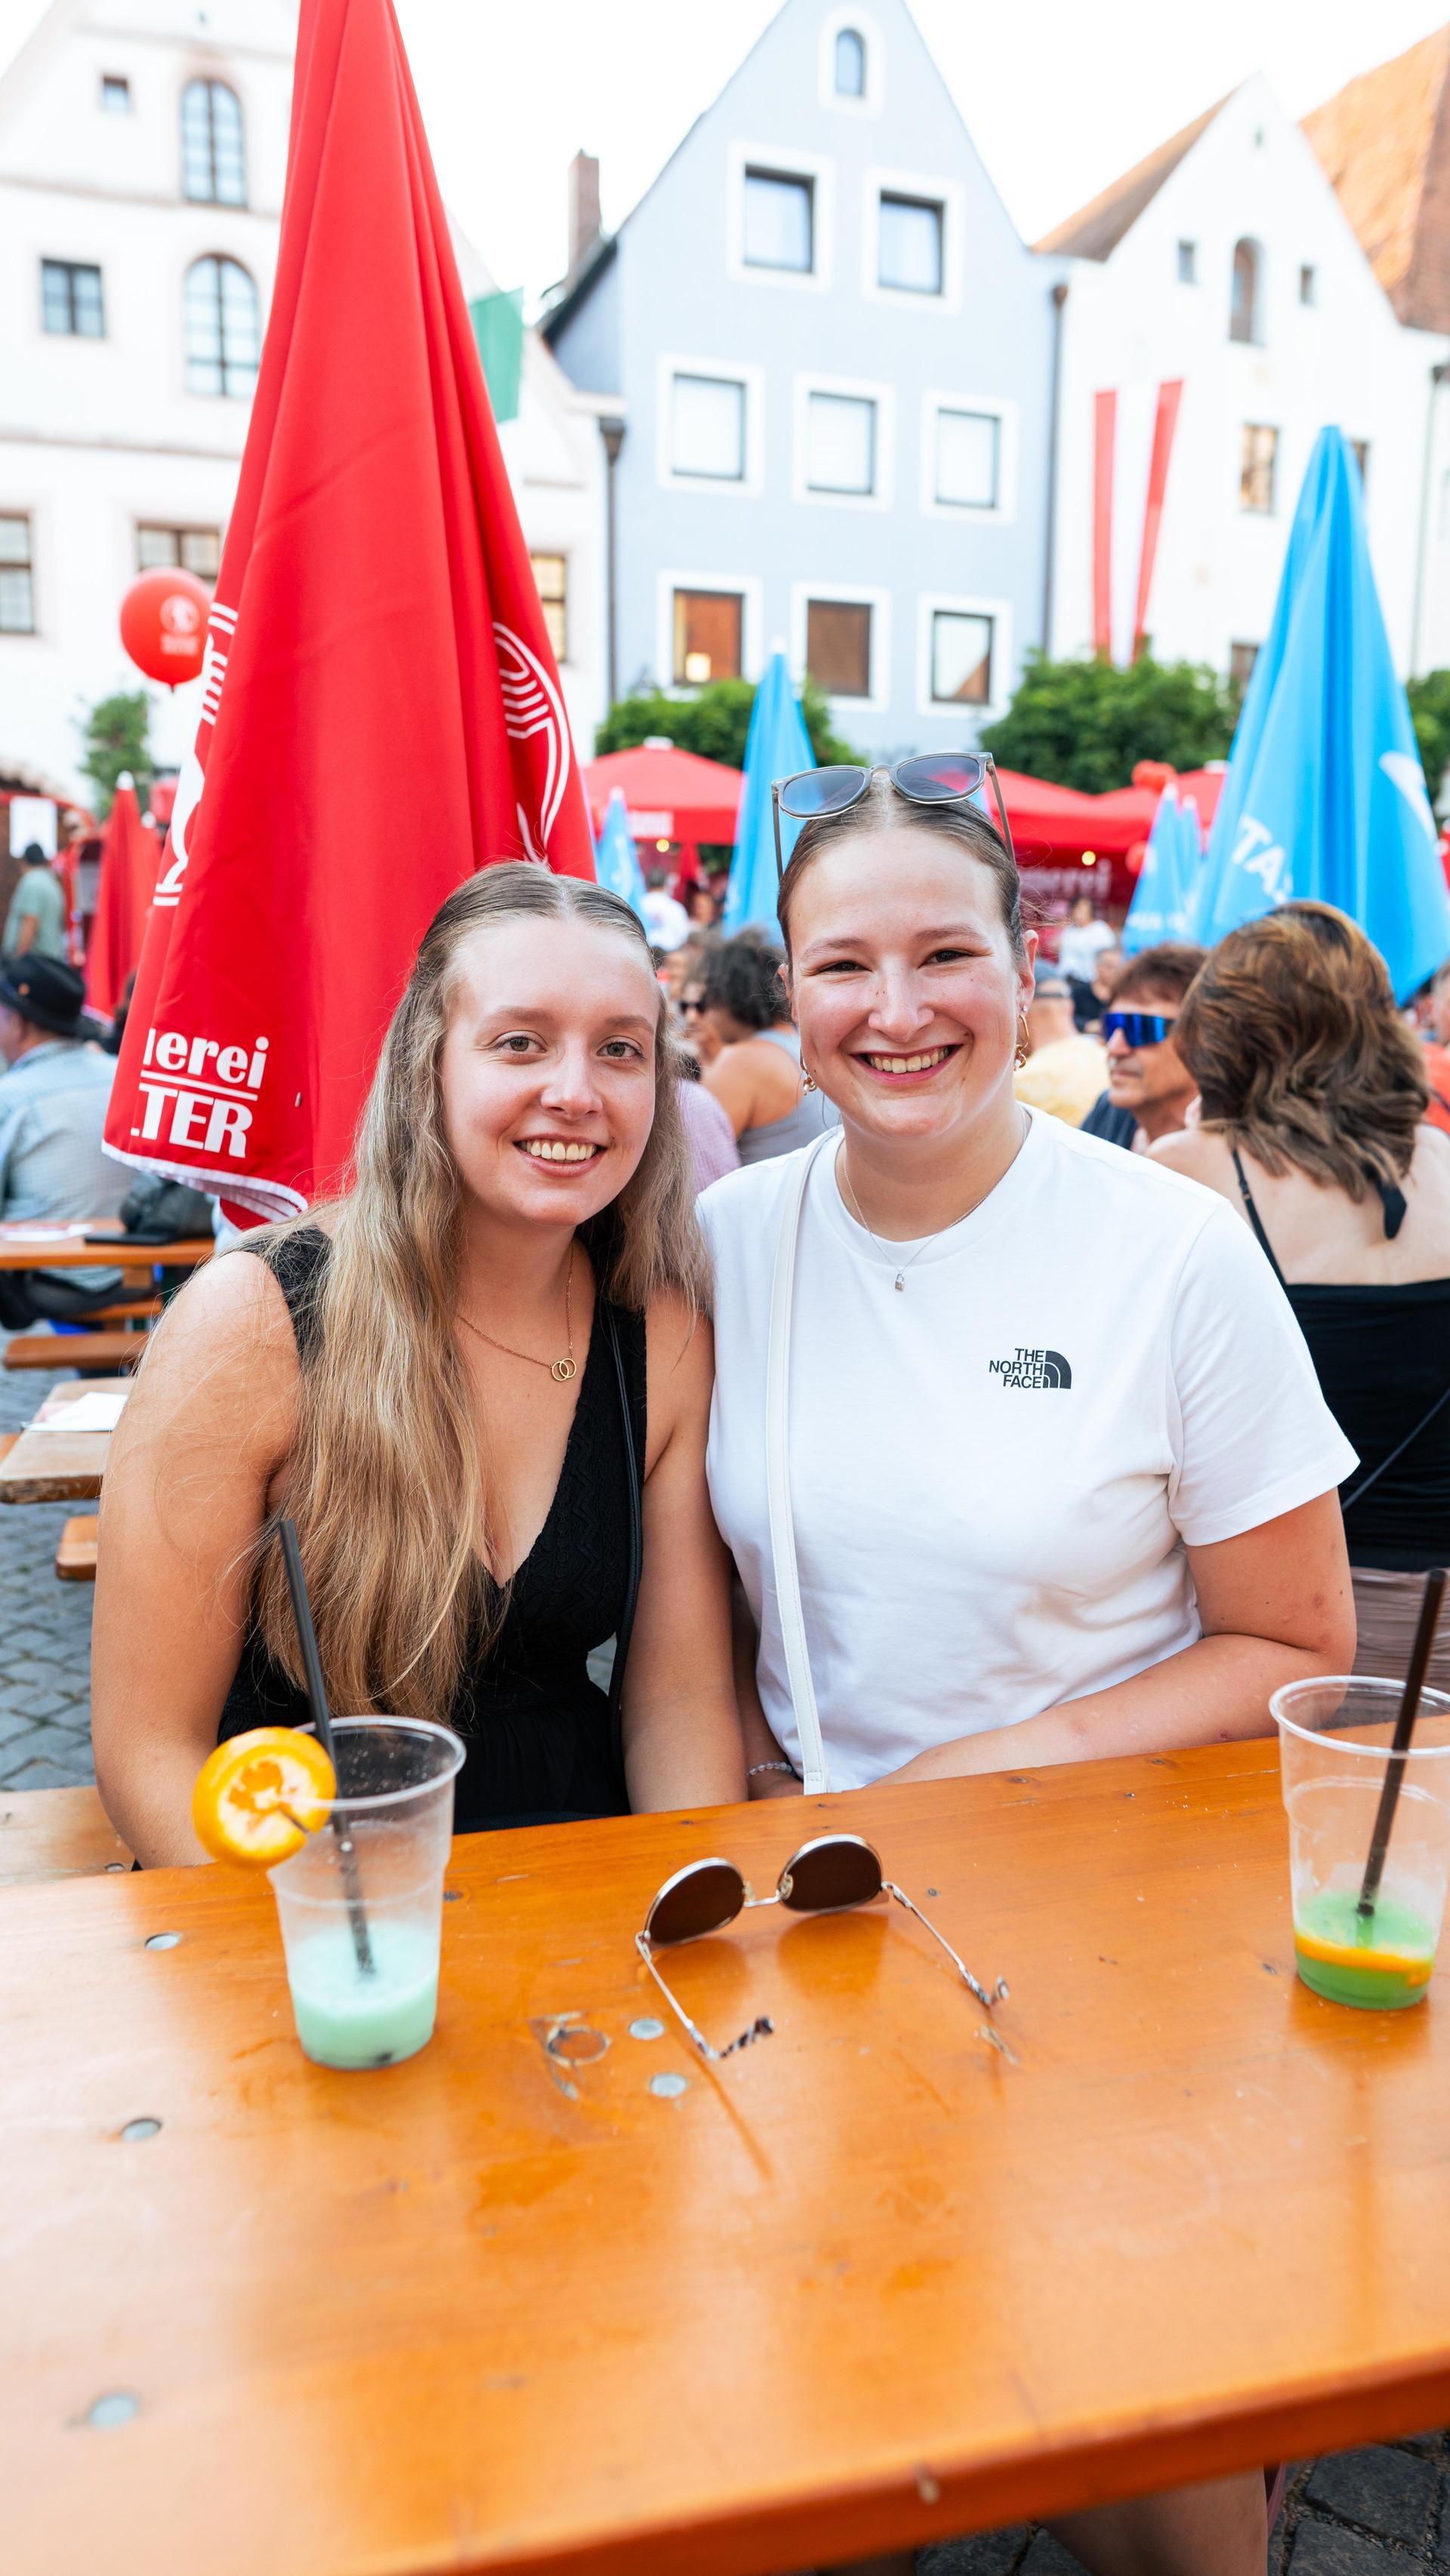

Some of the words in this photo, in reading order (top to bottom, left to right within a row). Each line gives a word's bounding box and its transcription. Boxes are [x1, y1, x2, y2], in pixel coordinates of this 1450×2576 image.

[130, 1082, 253, 1158] TER
[1014, 1348, 1044, 1363] THE
[989, 1360, 1044, 1376] NORTH
[1003, 1374, 1042, 1388] FACE
